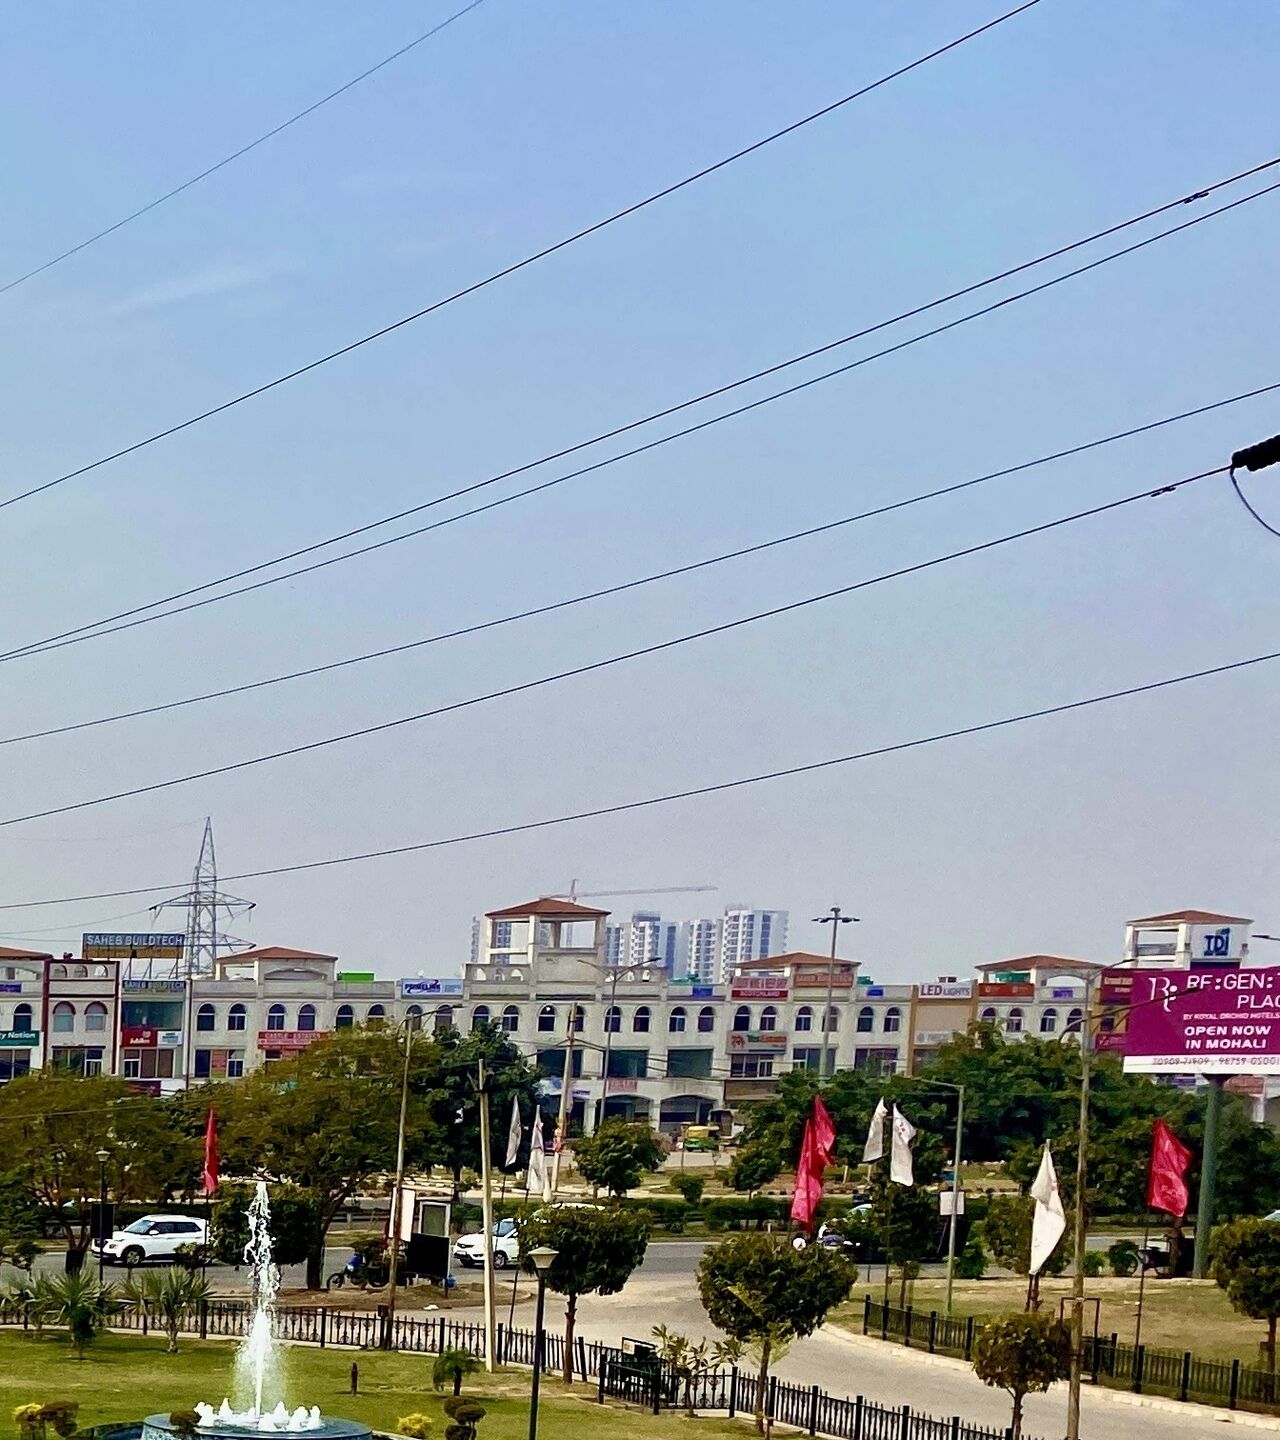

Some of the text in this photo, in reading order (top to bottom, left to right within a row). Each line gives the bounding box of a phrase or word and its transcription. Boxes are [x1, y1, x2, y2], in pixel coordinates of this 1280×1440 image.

[86, 935, 183, 946] SAHEB BUILDTECH
[1203, 928, 1231, 956] TDI
[920, 985, 970, 996] LED LIGHTS
[8, 1031, 36, 1039] Nation
[1184, 1025, 1271, 1036] OPEN NOW
[1185, 1038, 1267, 1049] IN MOHALI
